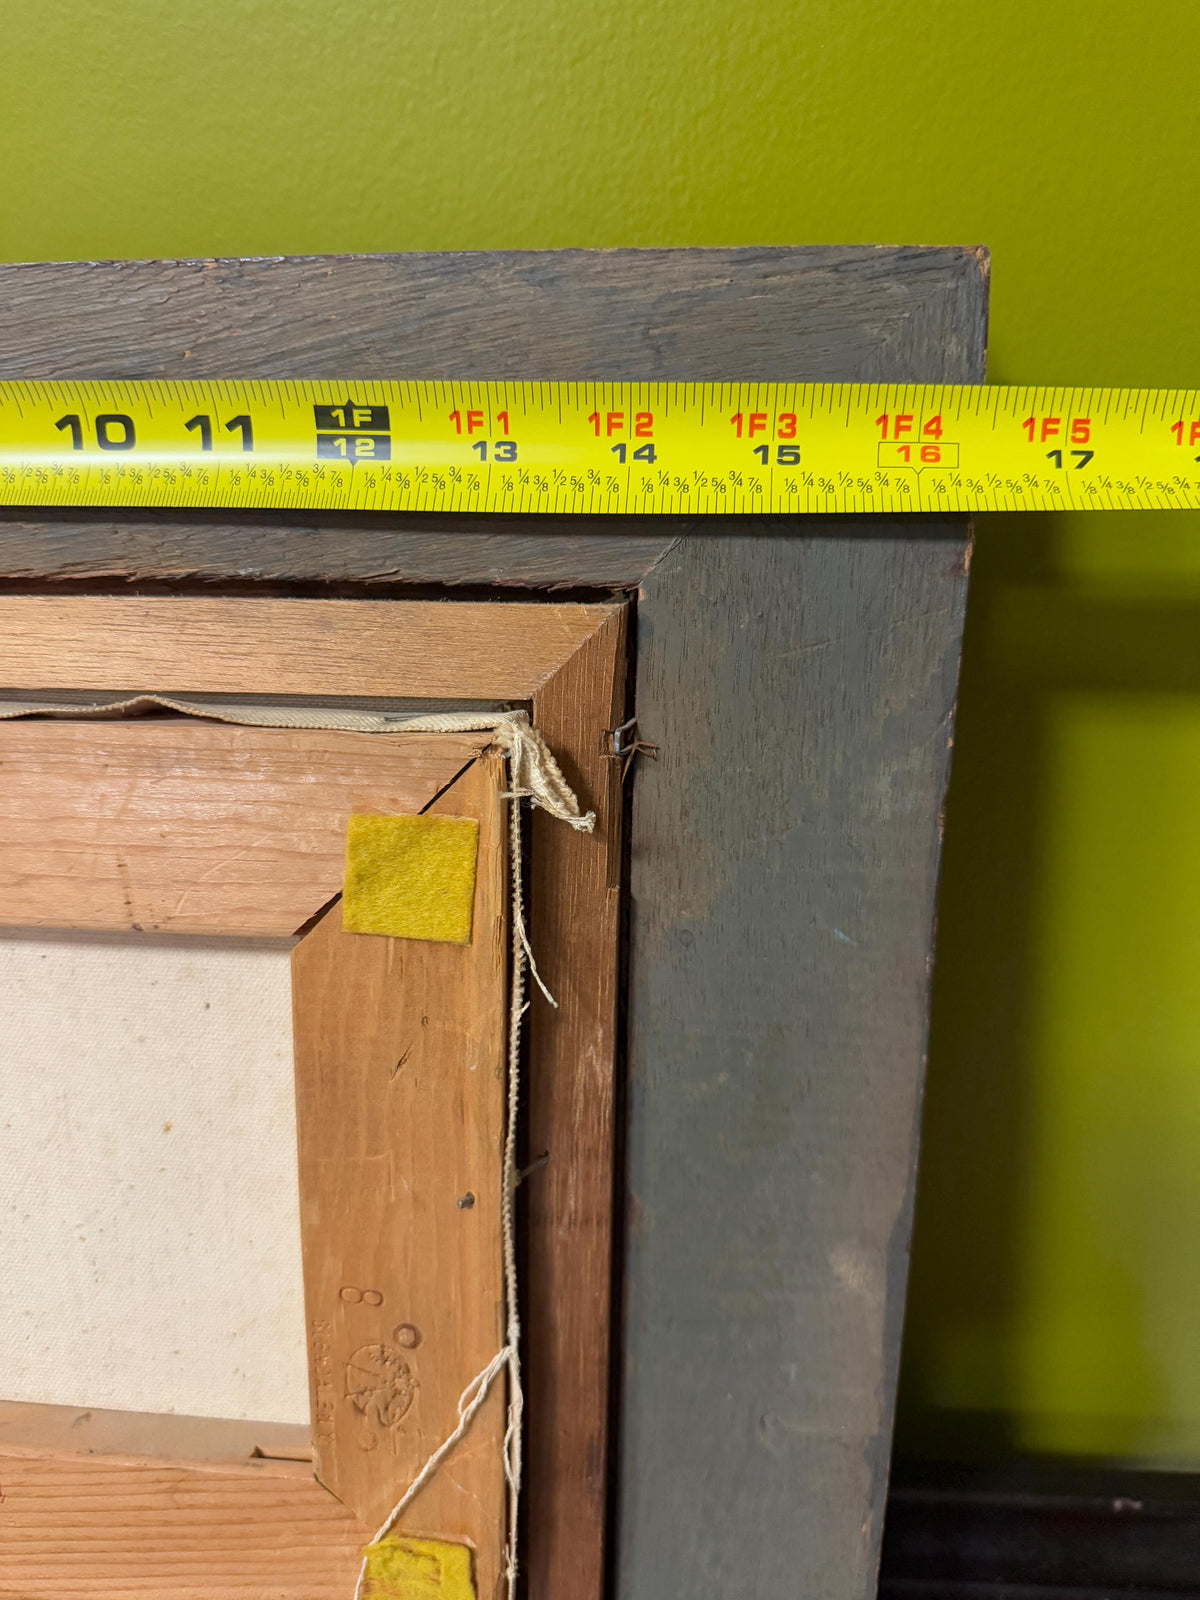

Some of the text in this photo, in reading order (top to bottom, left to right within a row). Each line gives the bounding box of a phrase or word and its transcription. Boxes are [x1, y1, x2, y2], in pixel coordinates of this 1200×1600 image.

[331, 409, 372, 427] 1F
[54, 414, 1094, 469] 10 11 12 13 14 15 16 17
[2, 467, 15, 483] 3/8
[21, 462, 32, 478] 1/2
[35, 469, 48, 484] 5/8
[51, 462, 64, 477] 3/4
[68, 468, 80, 484] 7/8
[100, 469, 111, 484] 1/8
[116, 463, 128, 478] 1/4
[130, 469, 143, 484] 3/8
[149, 463, 160, 478] 1/2
[163, 469, 176, 484] 5/8
[180, 463, 192, 477] 3/4
[197, 469, 209, 485] 7/8
[230, 470, 241, 486] 1/8
[246, 464, 257, 479] 1/4
[261, 470, 274, 486] 3/8
[280, 464, 292, 480] 1/2
[295, 471, 309, 487] 5/8
[313, 464, 325, 480] 3/4
[331, 471, 343, 488] 7/8
[365, 472, 376, 488] 1/8
[381, 465, 391, 481] 1/4
[395, 472, 410, 489] 3/8
[415, 466, 428, 482] 1/2
[432, 474, 446, 490] 5/8
[449, 467, 462, 483] 3/4
[467, 474, 480, 490] 7/8
[501, 475, 513, 491] 1/8
[518, 469, 529, 484] 1/4
[534, 475, 548, 492] 3/8
[553, 470, 566, 486] 1/2
[570, 476, 585, 492] 5/8
[588, 470, 600, 486] 3/4
[606, 477, 619, 492] 7/8
[641, 478, 653, 493] 1/8
[658, 471, 669, 486] 1/4
[674, 477, 689, 493] 3/8
[693, 471, 707, 487] 1/2
[712, 478, 726, 494] 5/8
[729, 471, 742, 487] 3/4
[748, 478, 762, 493] 7/8
[784, 478, 797, 493] 1/8
[801, 472, 814, 488] 1/4
[818, 478, 834, 493] 3/8
[838, 472, 853, 488] 1/2
[857, 478, 873, 493] 5/8
[874, 472, 889, 488] 3/4
[894, 478, 910, 493] 7/8
[932, 478, 946, 493] 1/8
[949, 472, 962, 487] 1/4
[966, 478, 984, 494] 3/8
[986, 473, 1002, 488] 1/2
[1006, 478, 1023, 494] 5/8
[1023, 473, 1039, 489] 3/4
[1044, 479, 1060, 494] 7/8
[1082, 480, 1097, 494] 1/8
[1098, 475, 1112, 489] 1/4
[1116, 481, 1135, 494] 3/8
[1135, 475, 1153, 490] 1/2
[1156, 481, 1175, 495] 5/8
[1173, 476, 1190, 490] 3/4
